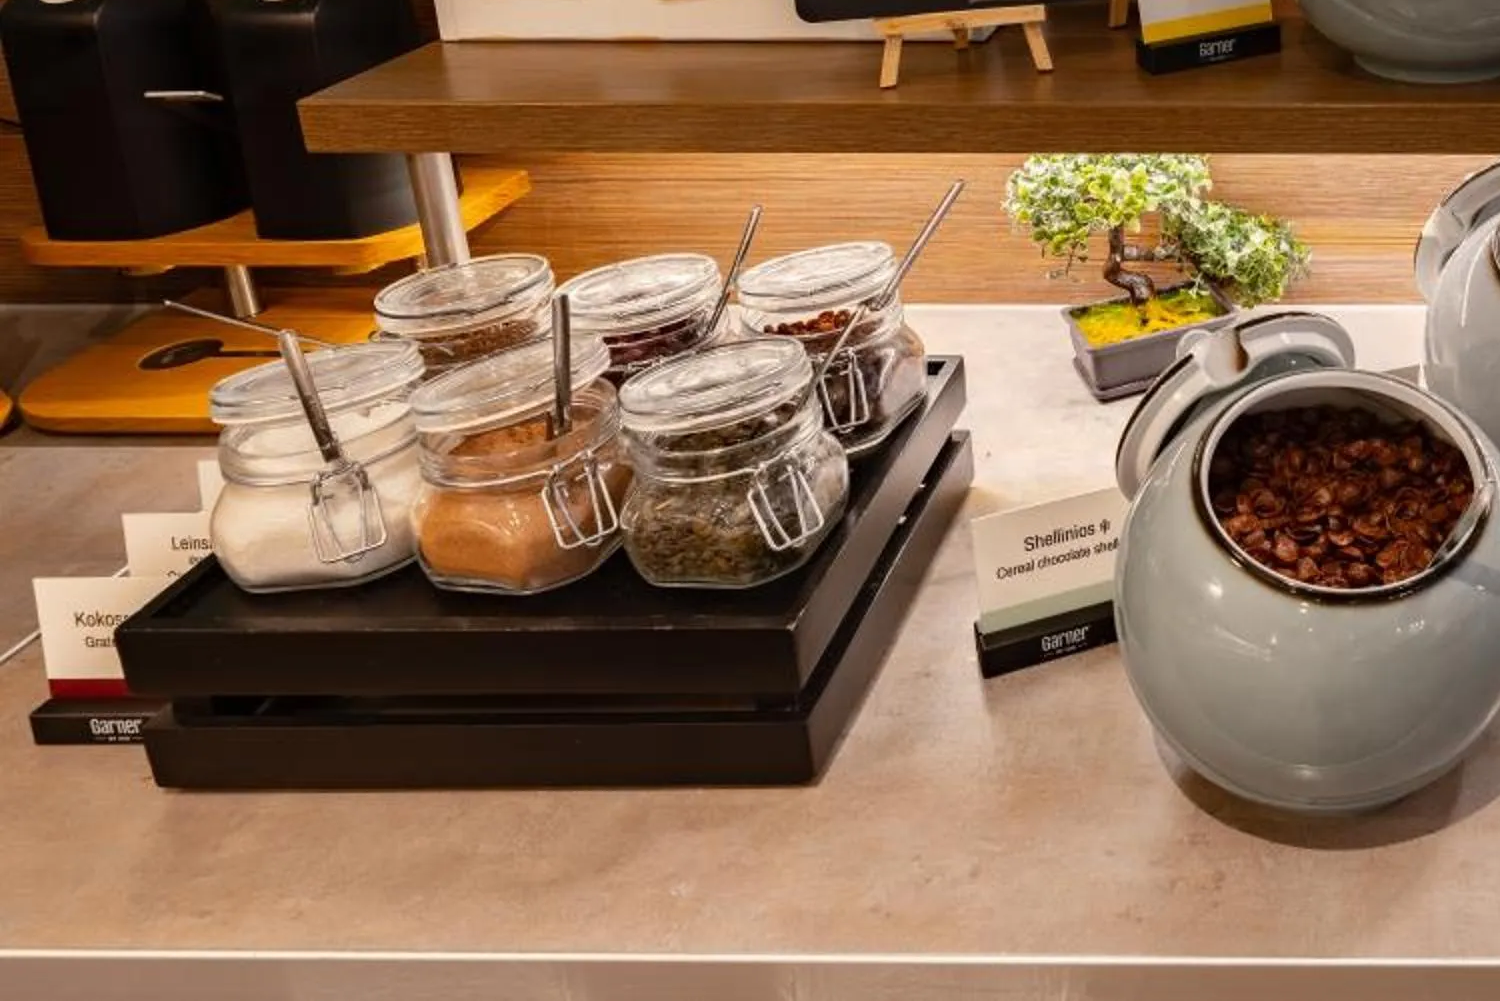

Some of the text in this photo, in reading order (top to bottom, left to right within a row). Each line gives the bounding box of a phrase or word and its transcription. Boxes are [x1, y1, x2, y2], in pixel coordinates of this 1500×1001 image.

[1023, 523, 1096, 553] Shellinios
[1041, 626, 1090, 653] Garner
[90, 718, 142, 735] Garner
